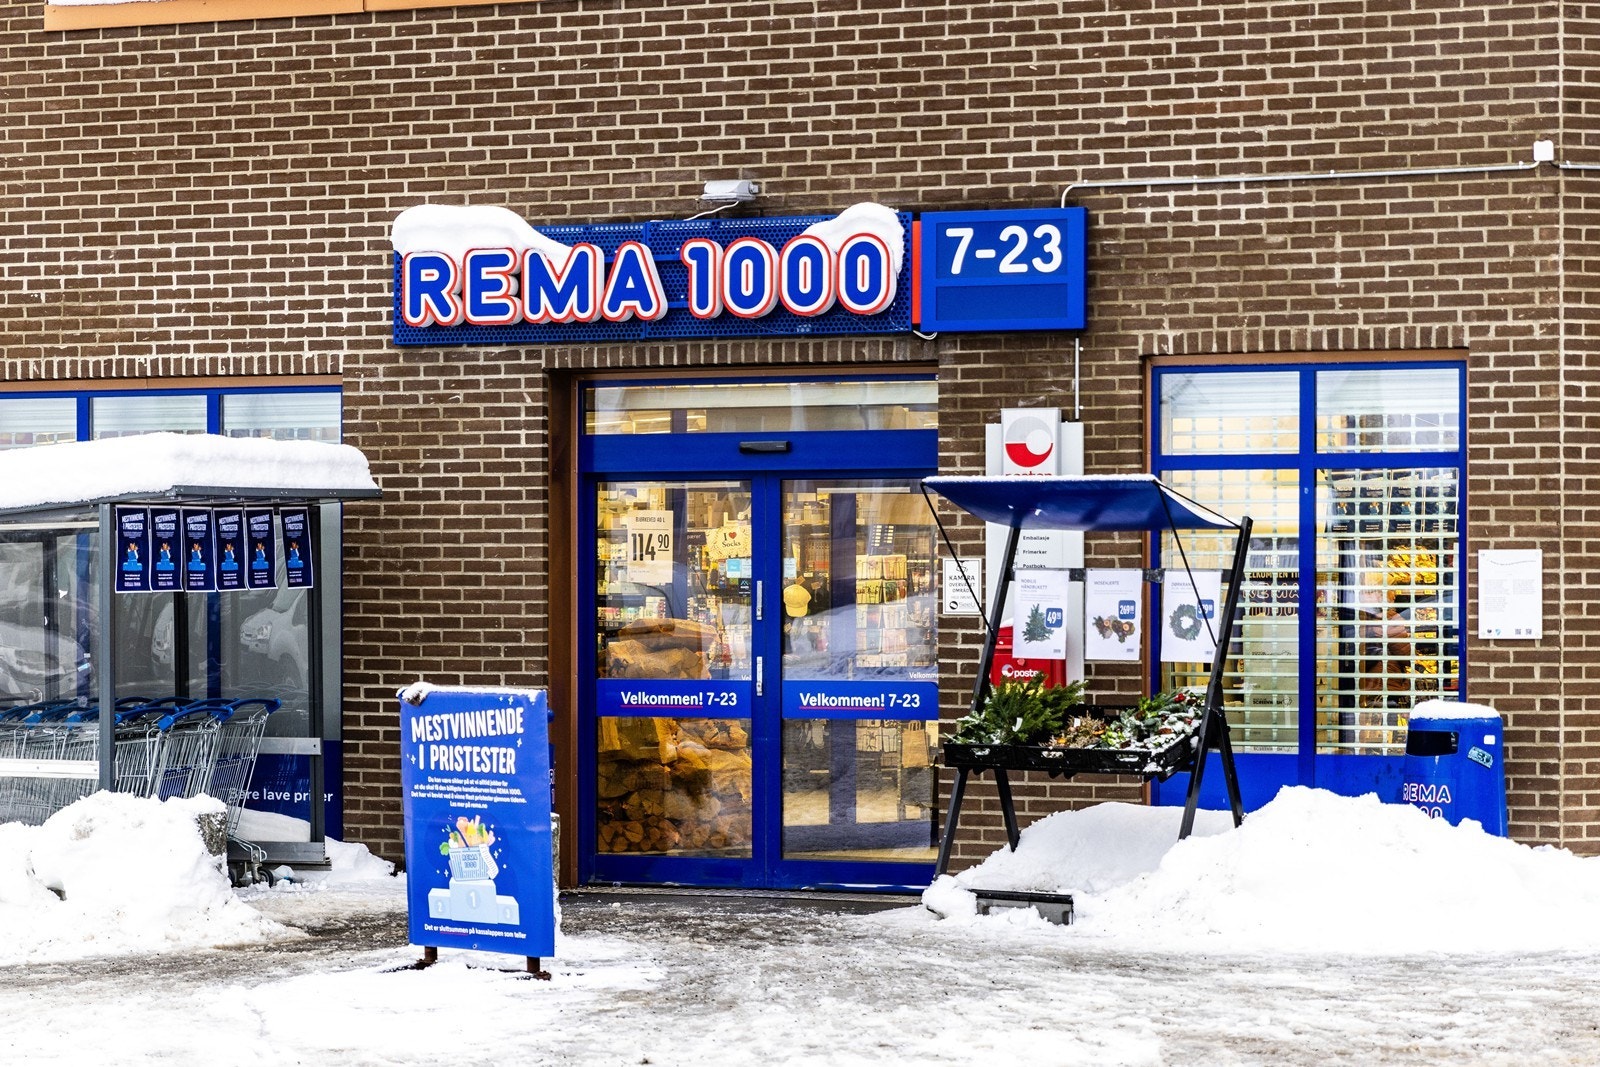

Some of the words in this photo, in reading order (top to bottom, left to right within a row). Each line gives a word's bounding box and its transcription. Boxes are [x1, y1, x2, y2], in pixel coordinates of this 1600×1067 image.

[945, 224, 1063, 275] 7-23
[402, 240, 669, 327] REMA
[680, 232, 897, 320] 1000
[631, 533, 656, 561] 114
[658, 534, 670, 548] 90
[721, 540, 741, 548] Socks
[1046, 612, 1057, 624] 49
[1014, 669, 1039, 678] poste
[620, 691, 703, 706] Velkommen!
[706, 692, 738, 706] 7-23
[800, 692, 885, 708] Velkommen!
[888, 694, 921, 708] 7-23
[411, 707, 524, 743] MESTVINNENDE
[419, 744, 424, 770] I
[430, 744, 516, 775] PRISTESTER
[263, 788, 291, 800] lave
[470, 891, 476, 908] 1
[469, 926, 475, 934] på
[476, 928, 504, 937] kassalappen
[514, 931, 527, 939] teller
